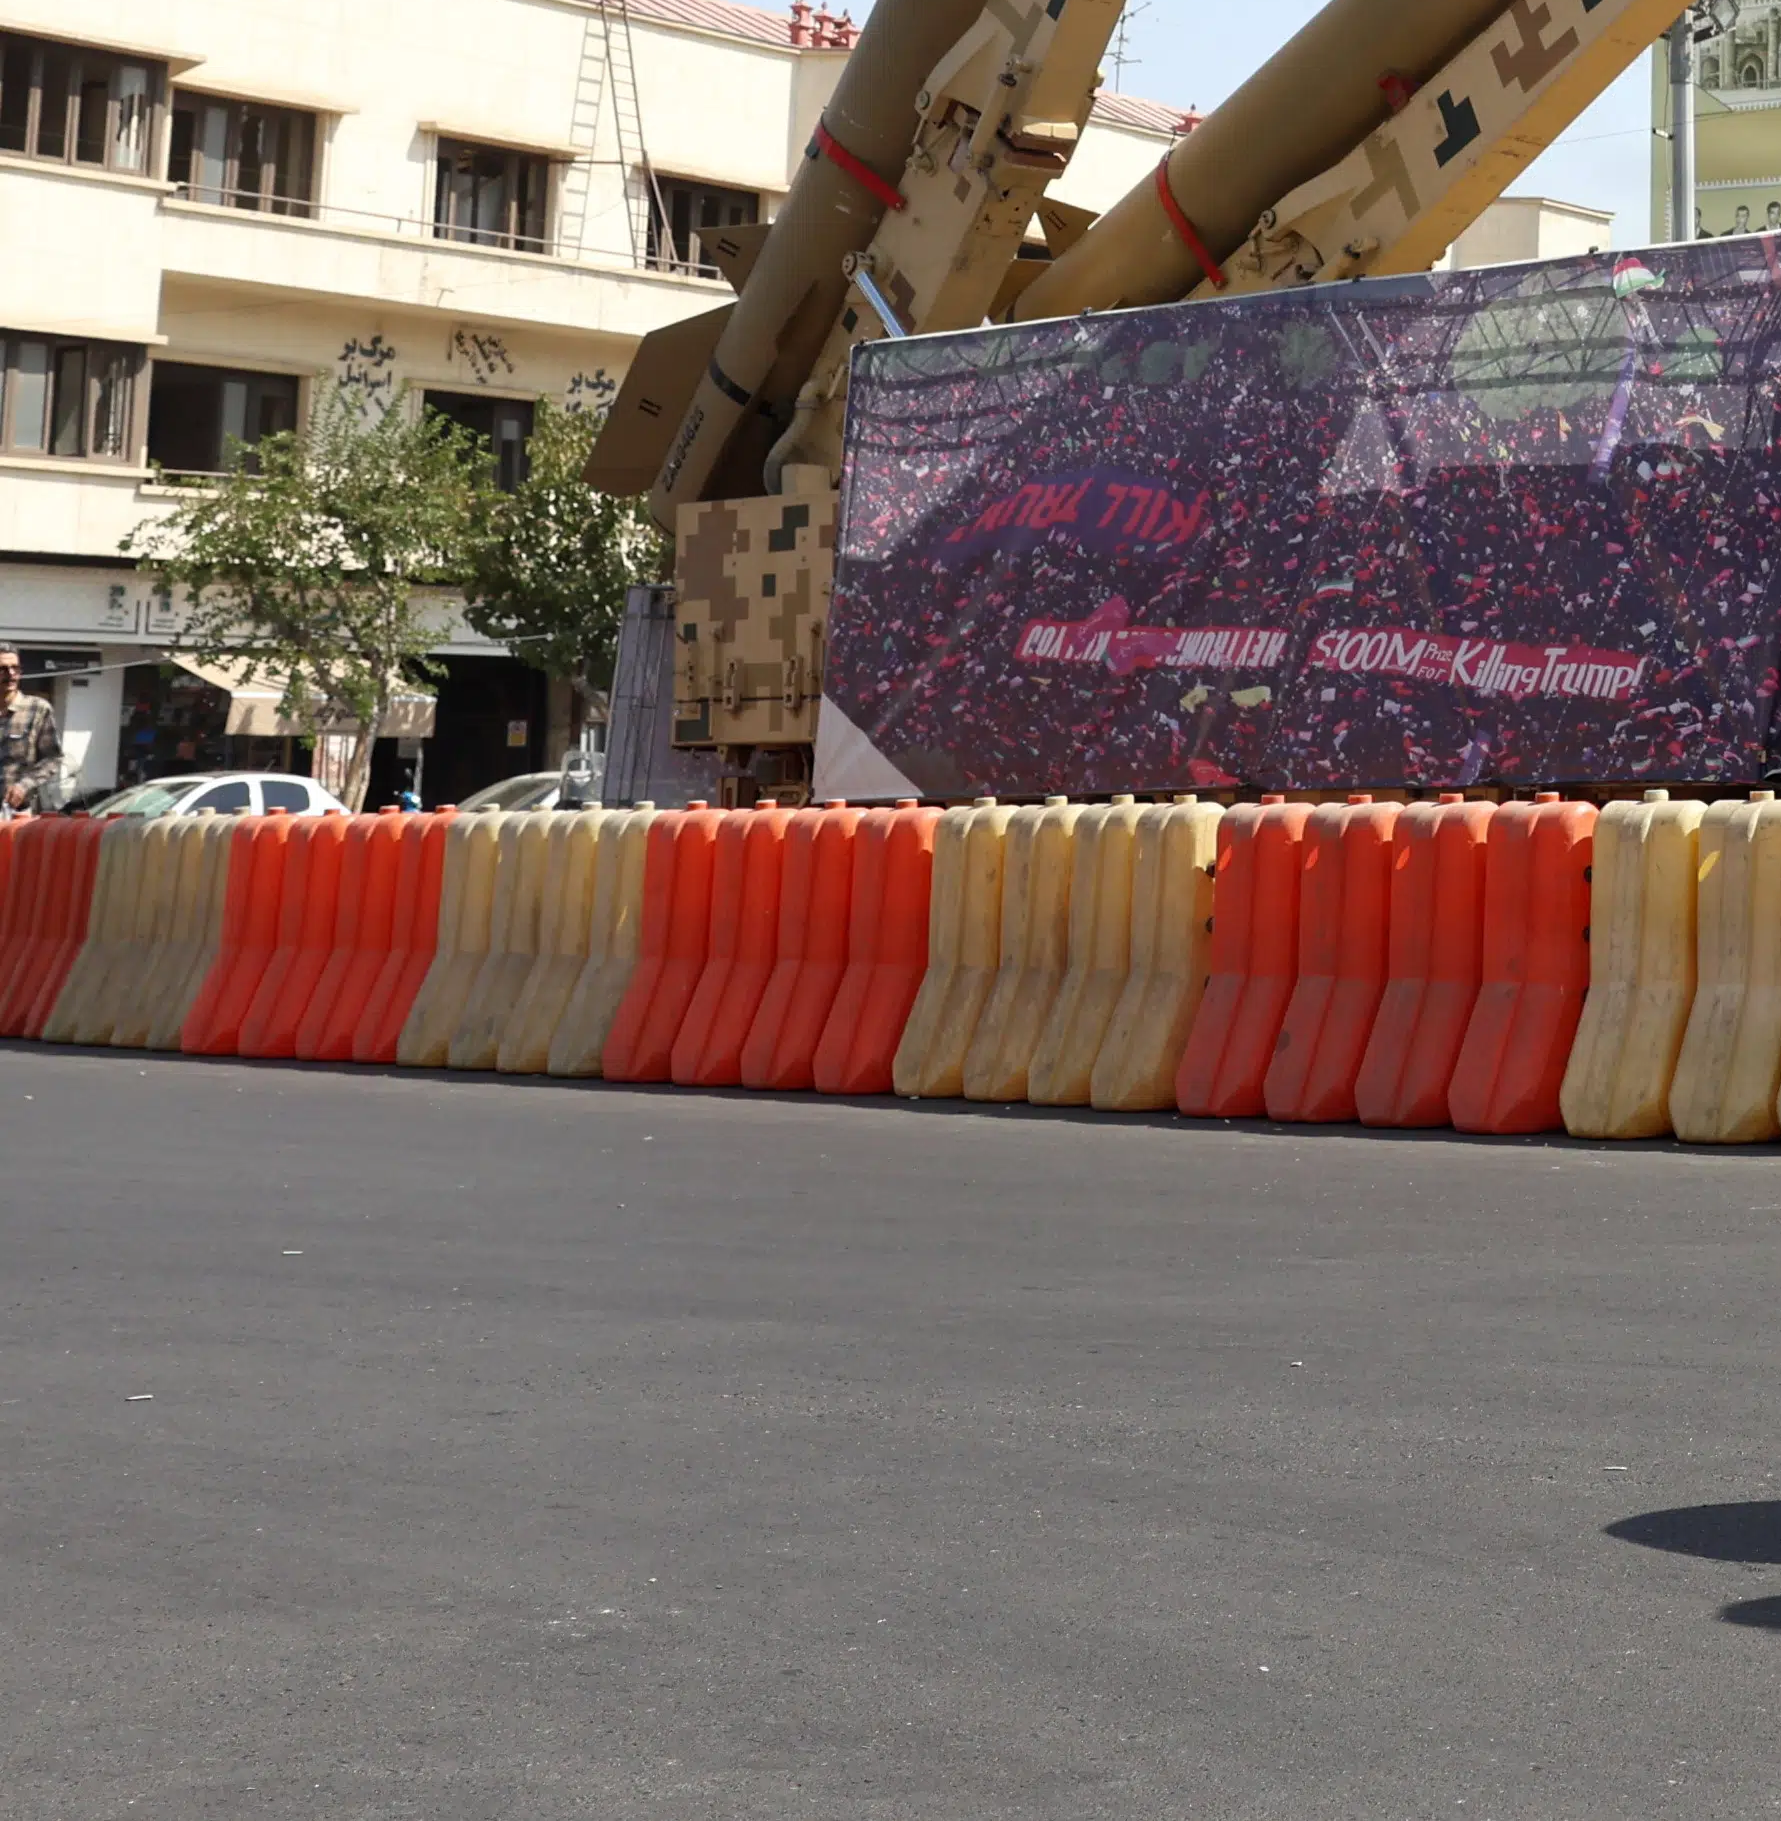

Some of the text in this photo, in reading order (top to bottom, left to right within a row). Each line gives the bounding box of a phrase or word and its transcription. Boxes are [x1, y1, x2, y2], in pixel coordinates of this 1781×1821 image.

[359, 335, 396, 366] مرگ
[1096, 482, 1211, 544] KILL
[1312, 631, 1426, 678] $100M
